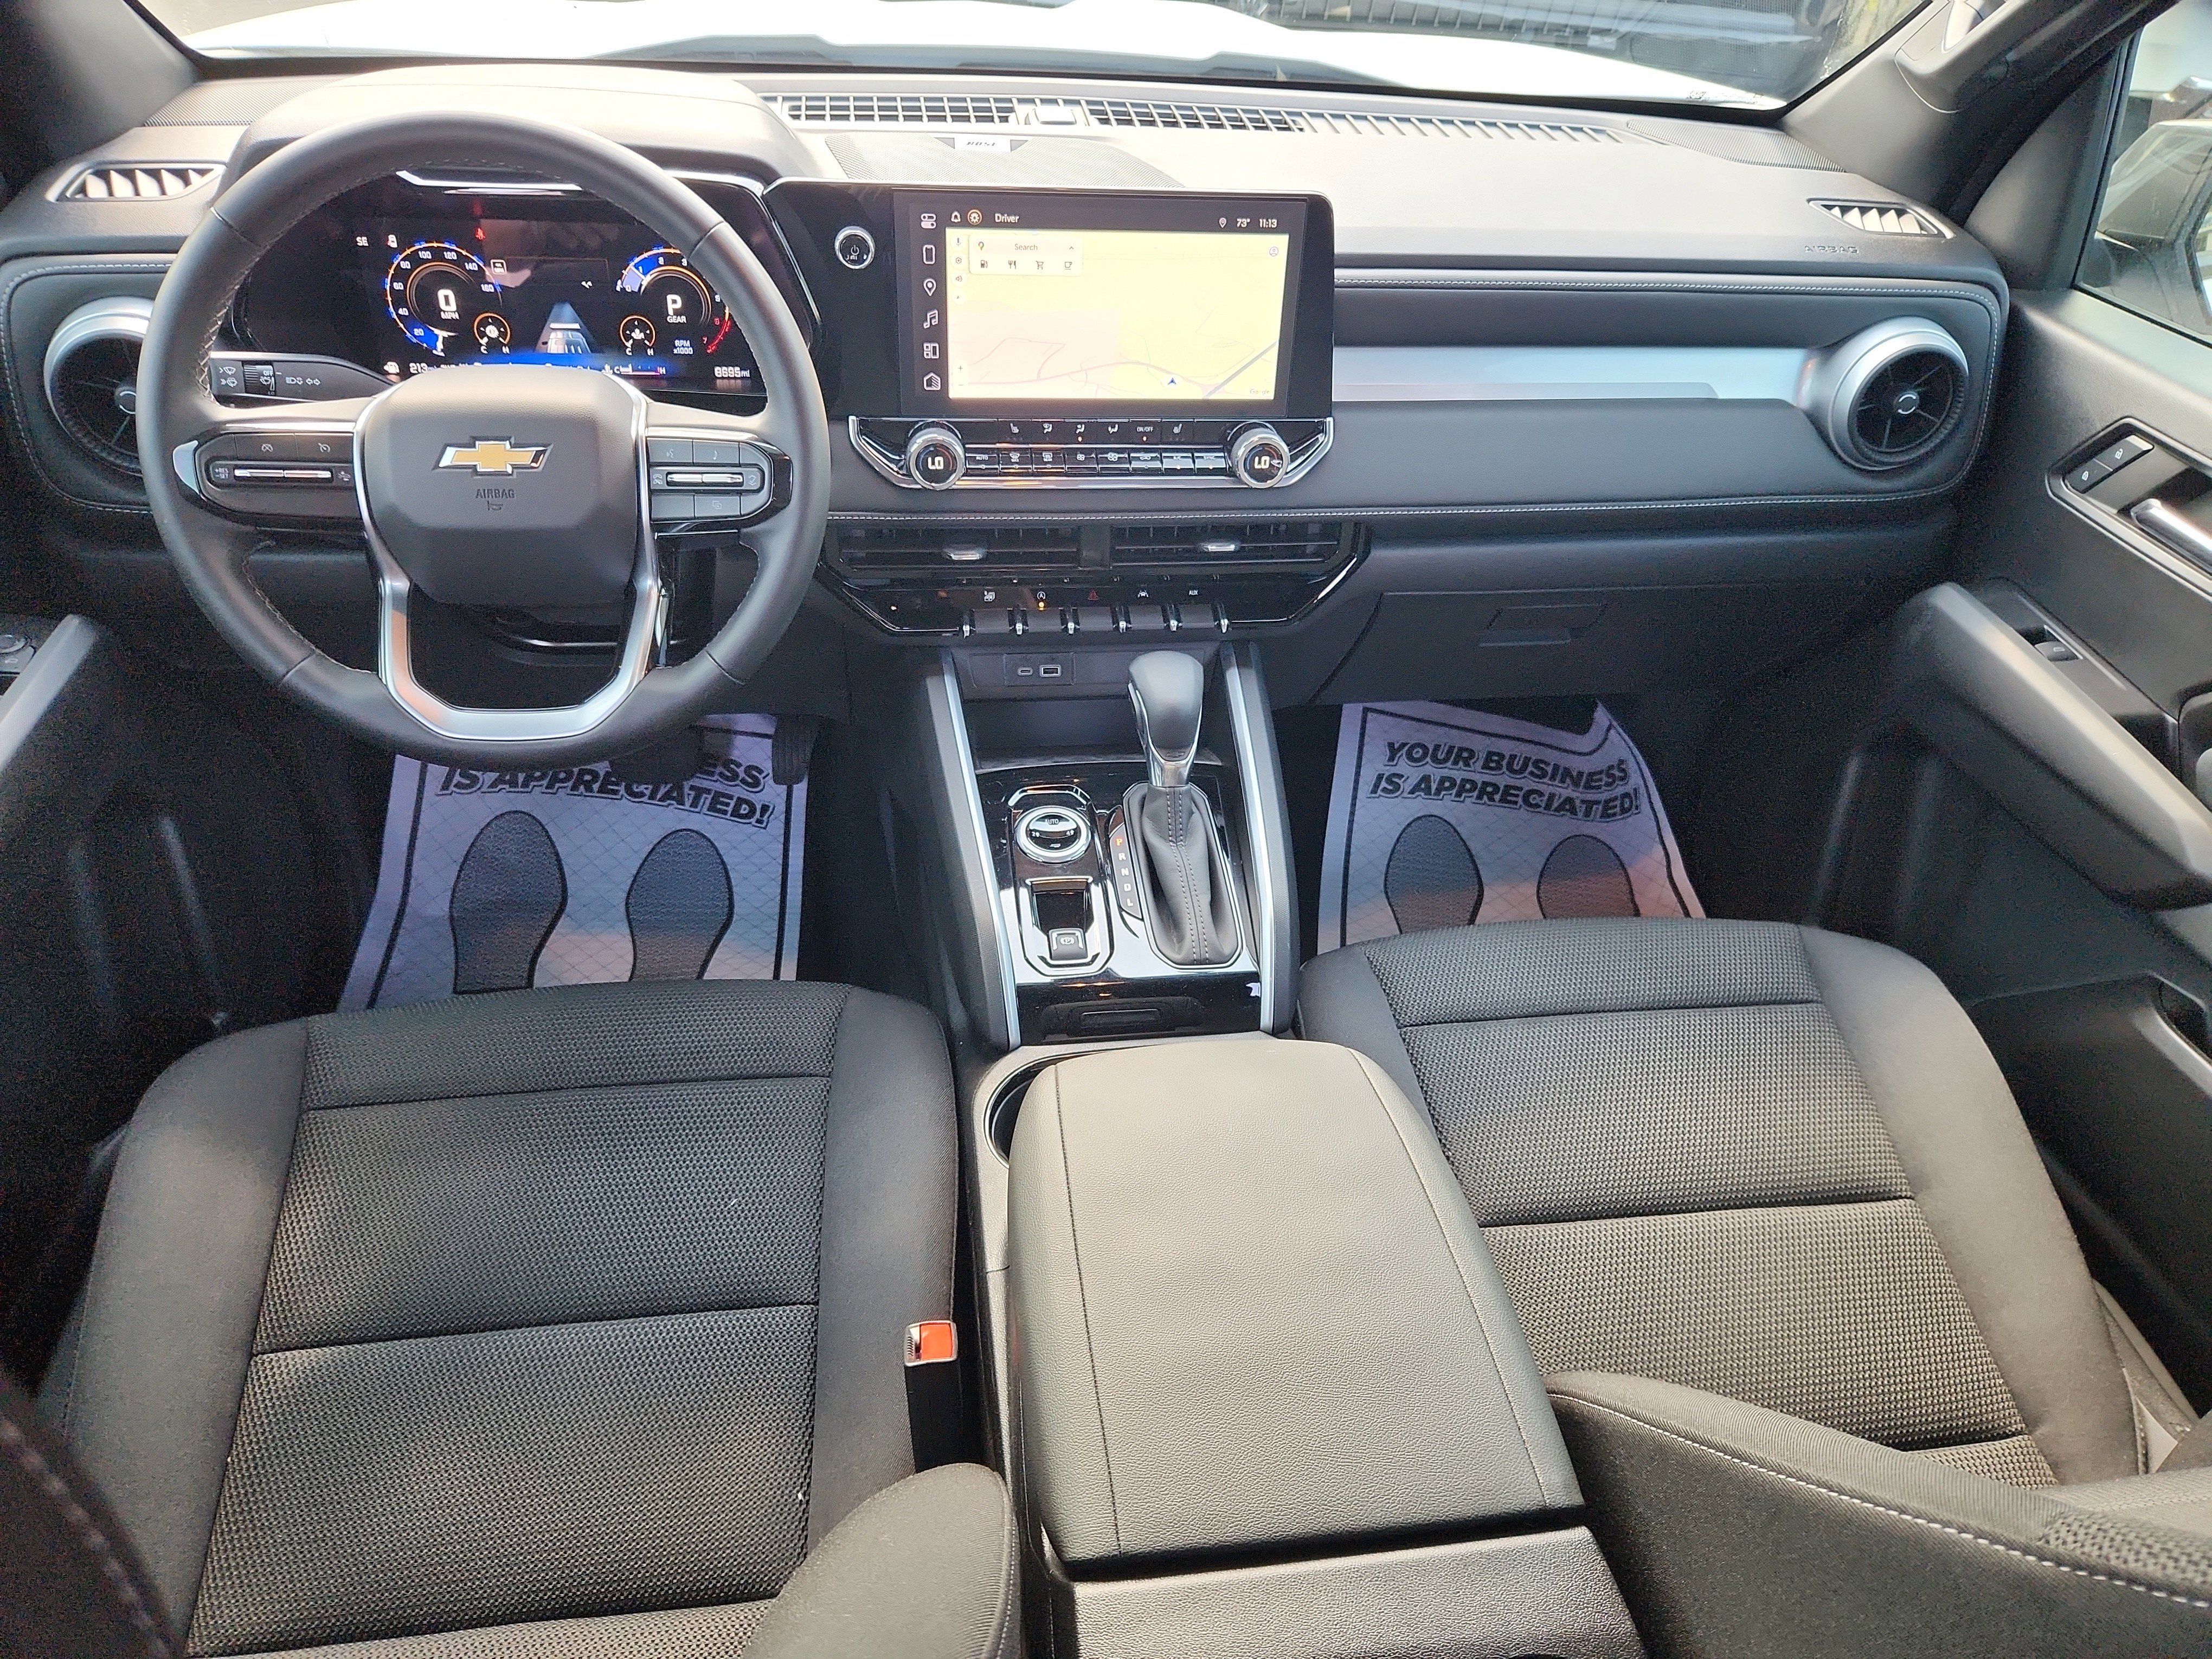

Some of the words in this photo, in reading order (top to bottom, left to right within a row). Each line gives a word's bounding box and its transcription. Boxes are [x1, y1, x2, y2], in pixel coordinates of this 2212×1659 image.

[995, 213, 1020, 223] Driver
[1237, 218, 1251, 228] 73°
[1259, 218, 1278, 228] 11:13
[418, 250, 432, 260] 100
[443, 251, 458, 260] 120
[465, 262, 479, 271] 140
[393, 282, 404, 291] 60
[480, 284, 495, 293] 160
[437, 288, 457, 312] 0
[666, 294, 683, 316] P
[397, 307, 409, 316] 40
[440, 311, 460, 320] MPH
[666, 316, 687, 324] GEAR
[413, 327, 425, 336] 20
[927, 456, 944, 470] LO
[1254, 455, 1270, 470] LO
[475, 488, 515, 499] AIRBAG
[1384, 740, 1481, 770] YOUR
[1480, 750, 1630, 793] BUSINESS
[1366, 771, 1407, 799] IS
[1404, 772, 1642, 822] APPRECIATED!
[1116, 838, 1123, 846] P
[1118, 852, 1127, 861] R
[1121, 867, 1129, 876] N
[1123, 883, 1131, 892] D
[1127, 898, 1134, 907] L
